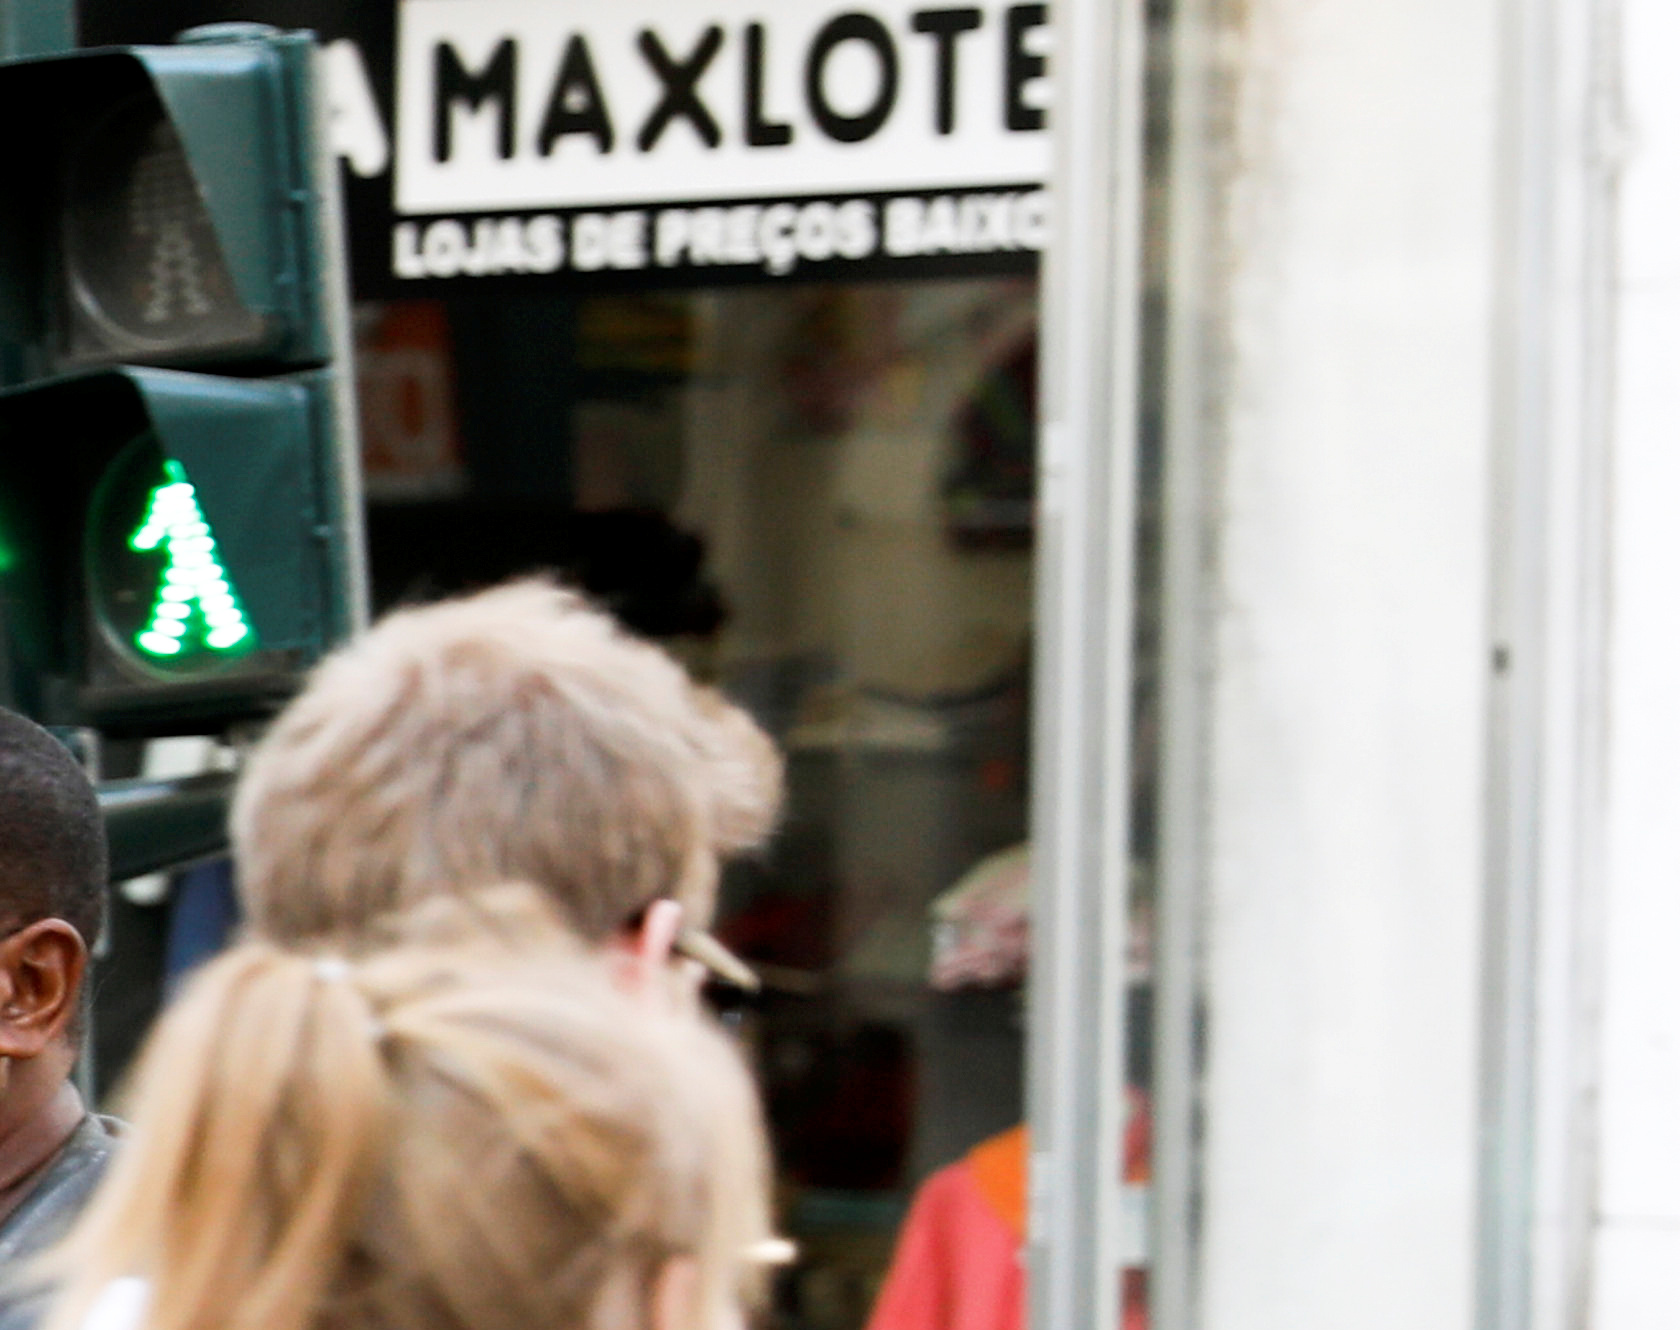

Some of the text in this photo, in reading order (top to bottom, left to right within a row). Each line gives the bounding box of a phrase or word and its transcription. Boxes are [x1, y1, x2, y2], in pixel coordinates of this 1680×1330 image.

[433, 3, 1046, 163] MAXLOTE
[393, 191, 1054, 277] LOJAS DE PREÇOS BAIXO
